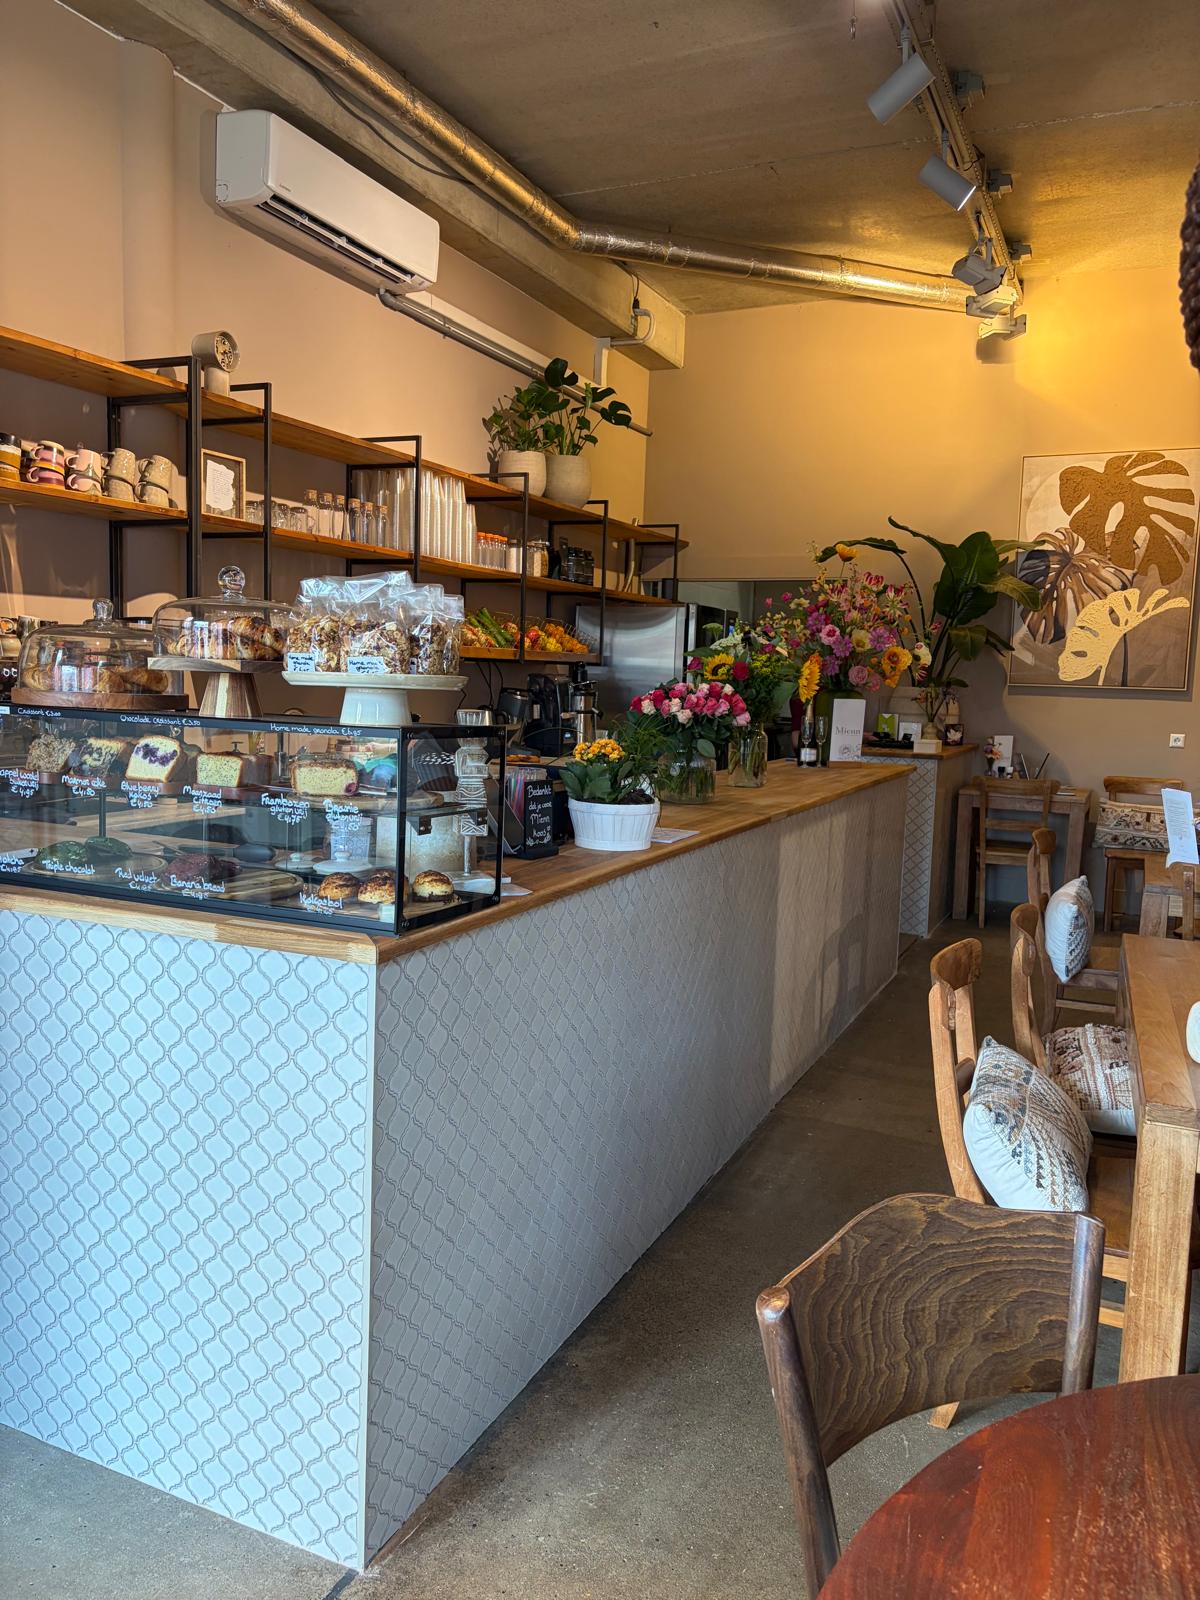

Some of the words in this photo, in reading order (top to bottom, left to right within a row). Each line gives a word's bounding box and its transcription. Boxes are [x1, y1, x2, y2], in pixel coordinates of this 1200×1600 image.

[270, 723, 290, 732] Home
[313, 727, 339, 735] granola
[527, 784, 552, 798] Bedankt
[261, 792, 310, 809] Frambozen
[170, 874, 201, 889] Banana
